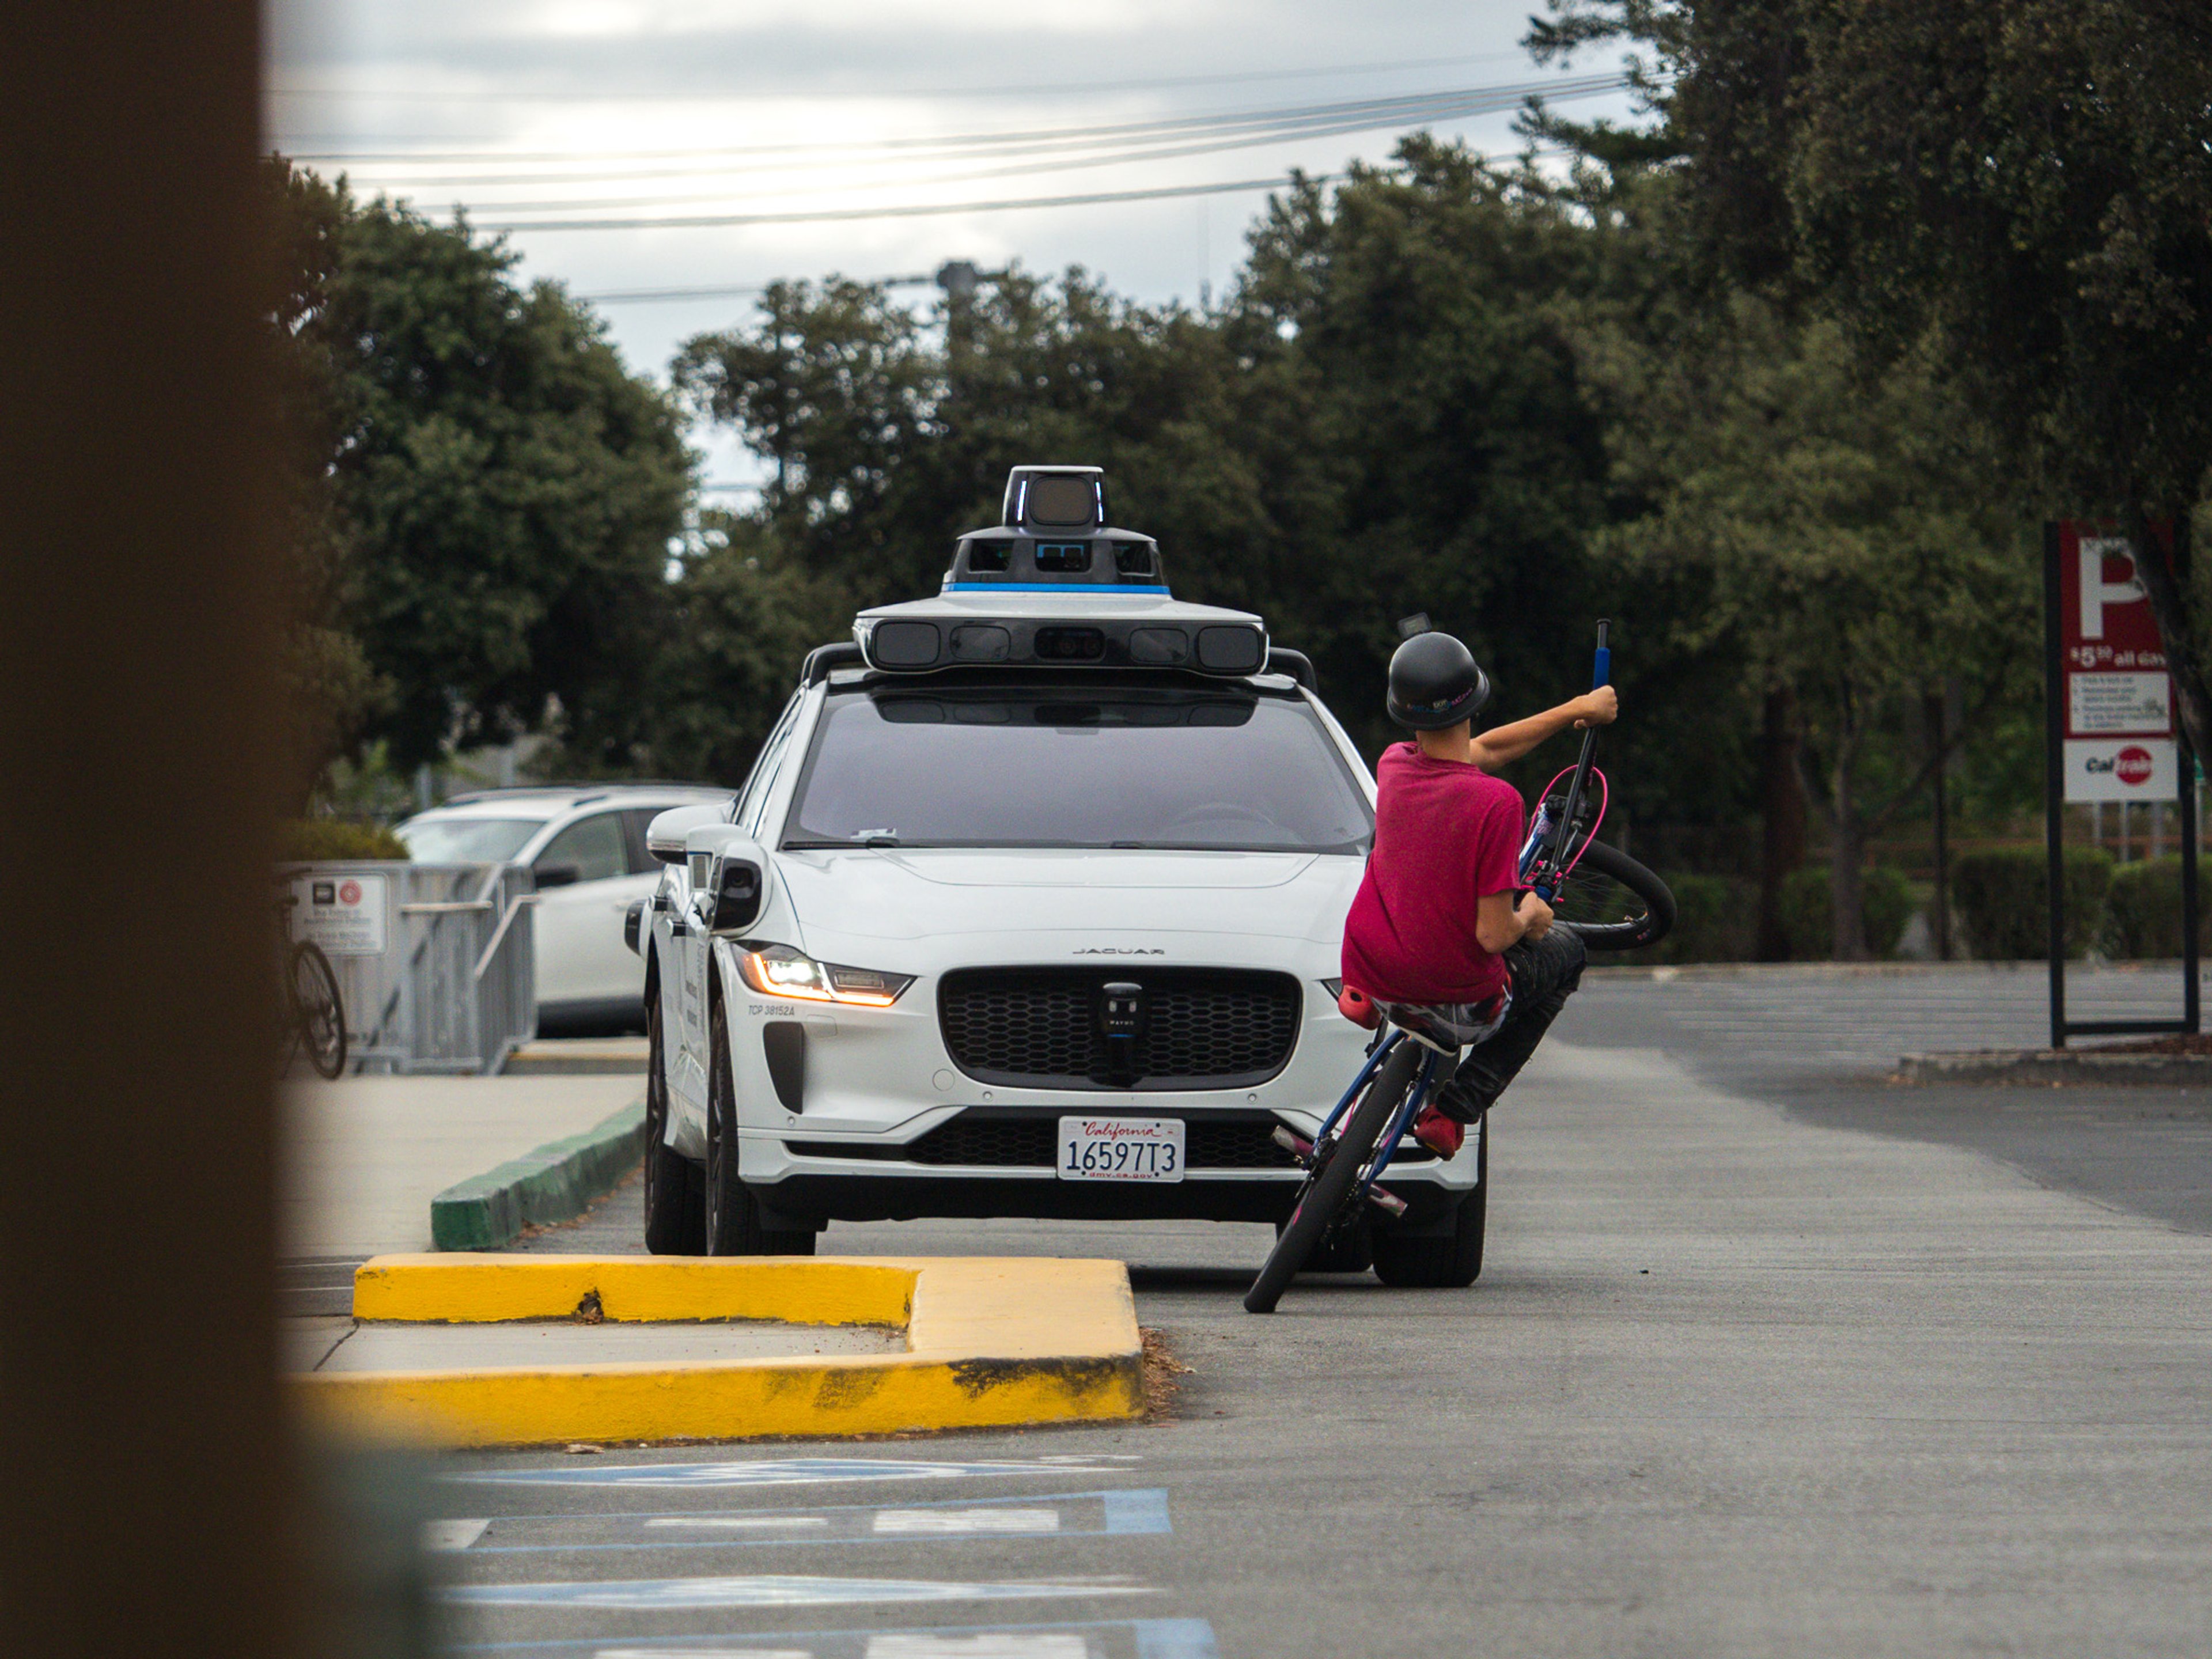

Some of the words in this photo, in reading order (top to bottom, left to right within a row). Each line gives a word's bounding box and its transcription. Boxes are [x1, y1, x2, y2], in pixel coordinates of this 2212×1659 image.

[2080, 537, 2148, 638] P
[2114, 650, 2135, 666] all
[748, 1005, 763, 1015] TCP
[765, 1005, 795, 1016] 38152A
[1085, 1121, 1162, 1140] California
[1066, 1141, 1176, 1172] 16597T3
